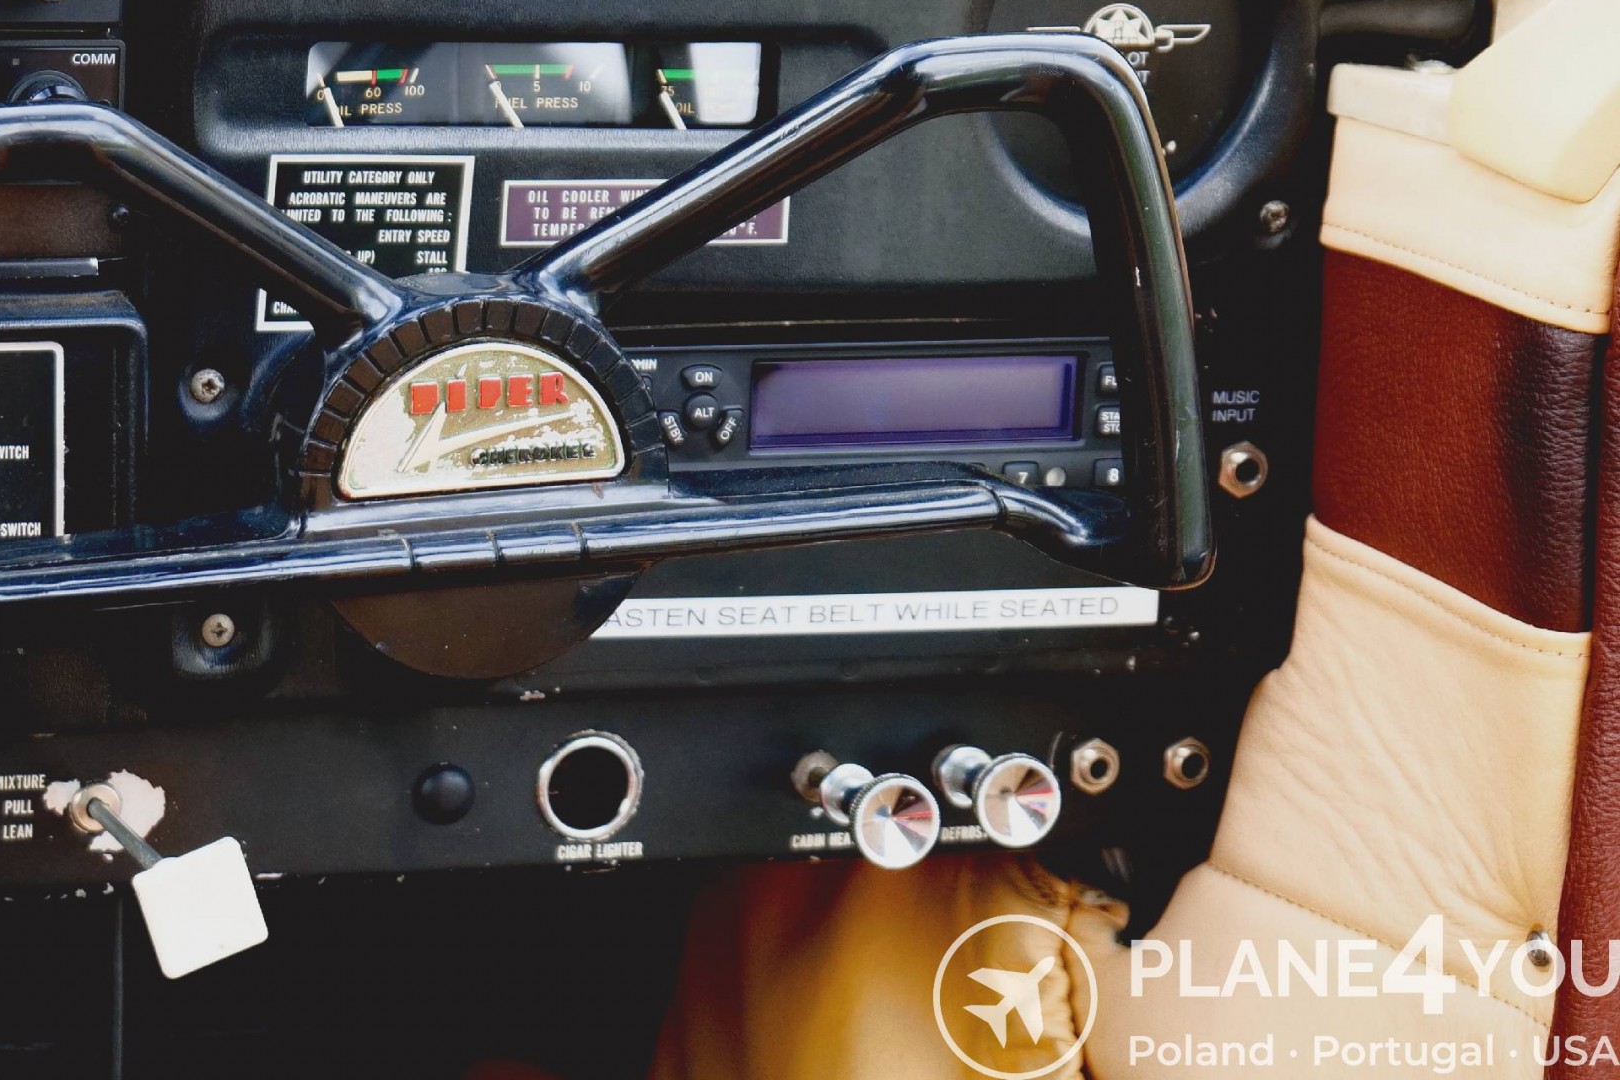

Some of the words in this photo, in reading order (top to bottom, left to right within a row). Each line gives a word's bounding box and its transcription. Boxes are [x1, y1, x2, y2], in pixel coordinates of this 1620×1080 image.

[72, 54, 115, 64] COMM
[540, 96, 578, 108] PRESS
[304, 171, 345, 183] UTILITY
[349, 171, 402, 183] CATEGORY
[408, 171, 434, 183] ONLY
[289, 192, 346, 206] ACROBATIC
[355, 192, 417, 206] MANEUVERS
[425, 192, 446, 206] ARE
[529, 190, 548, 203] OIL
[561, 190, 610, 203] COOLER
[379, 230, 411, 243] ENTRY
[417, 230, 450, 243] SPEED
[694, 372, 713, 382] ON
[1213, 391, 1260, 404] MUSIC
[694, 407, 714, 418] ALT
[1213, 409, 1255, 421] INPUT
[719, 603, 793, 625] SEAT
[809, 603, 880, 622] BELT
[895, 600, 981, 620] WHILE
[1001, 597, 1118, 618] SEATED
[5, 800, 33, 814] PULL
[3, 825, 33, 839] LEAN
